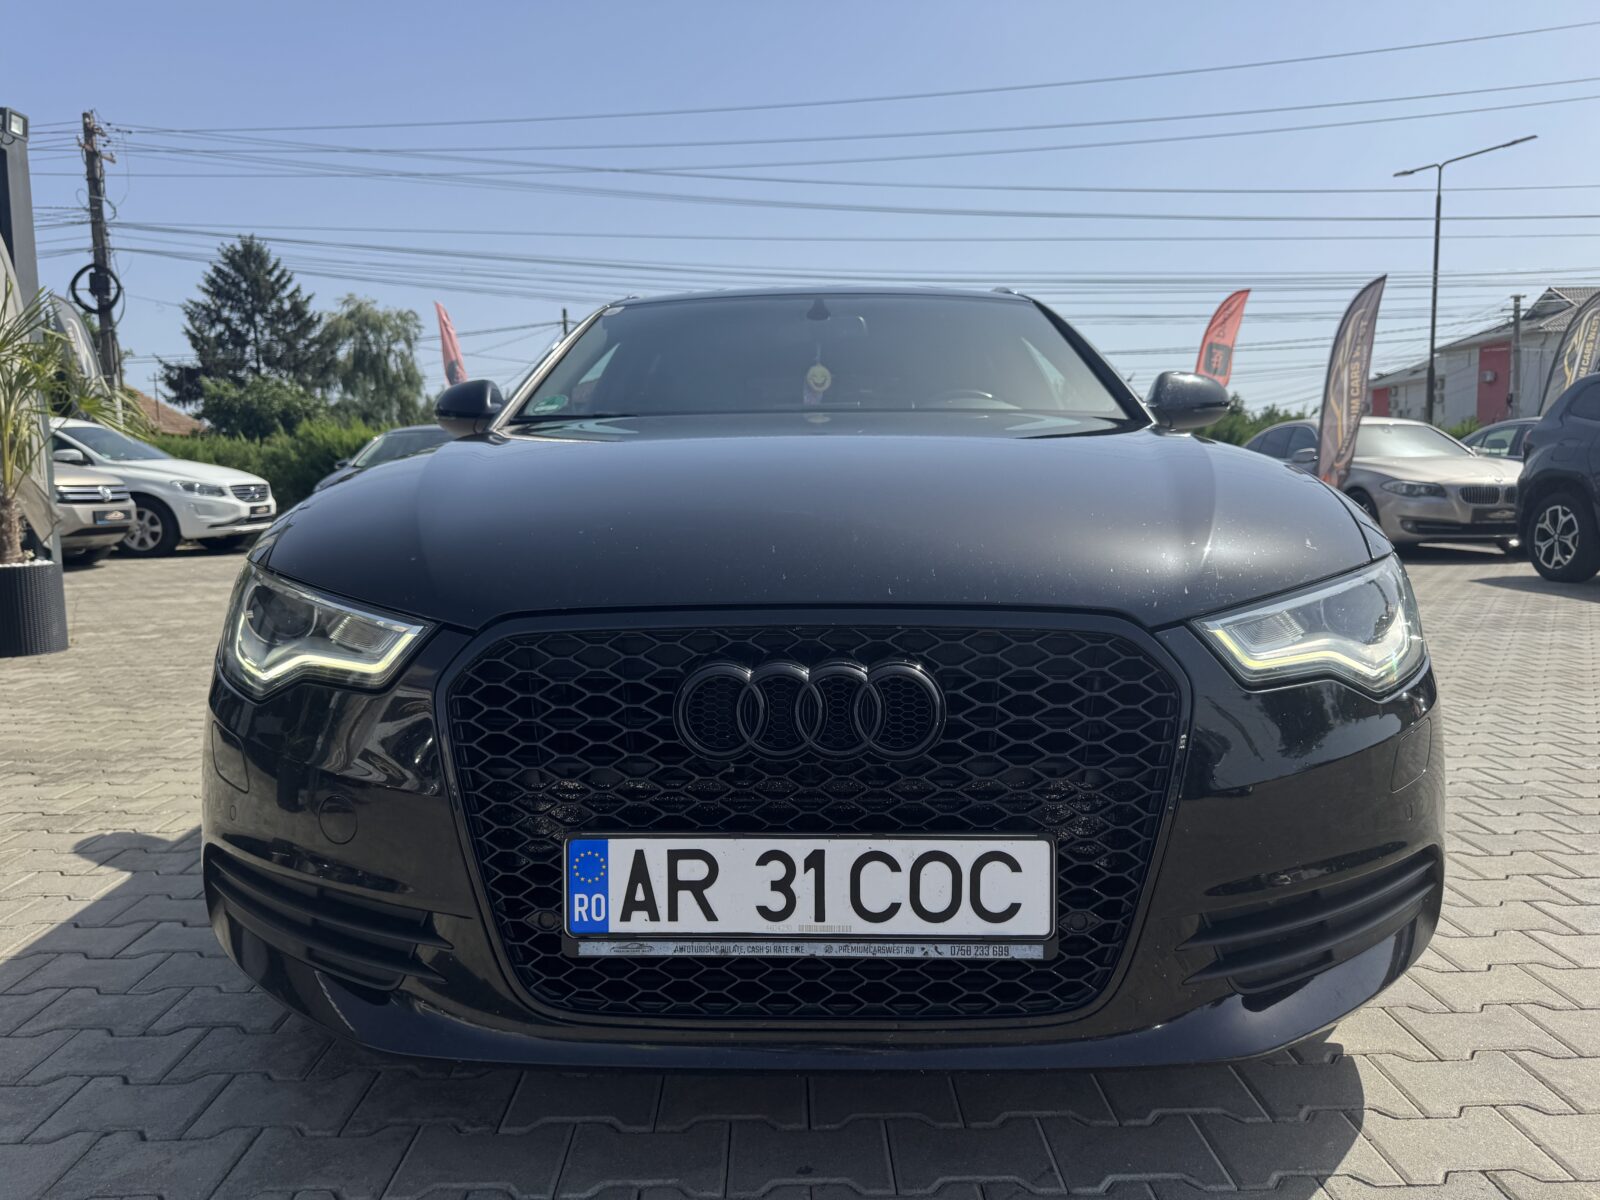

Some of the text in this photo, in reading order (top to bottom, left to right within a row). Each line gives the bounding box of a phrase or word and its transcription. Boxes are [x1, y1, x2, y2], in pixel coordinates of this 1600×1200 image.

[1351, 320, 1368, 358] WST
[1581, 342, 1593, 366] CARS
[1350, 363, 1361, 395] CARS
[619, 849, 1023, 924] AR 31 COC
[574, 894, 606, 922] RO
[747, 945, 764, 954] CASH
[773, 945, 789, 954] RATE
[950, 945, 1010, 957] 0758 233 699
